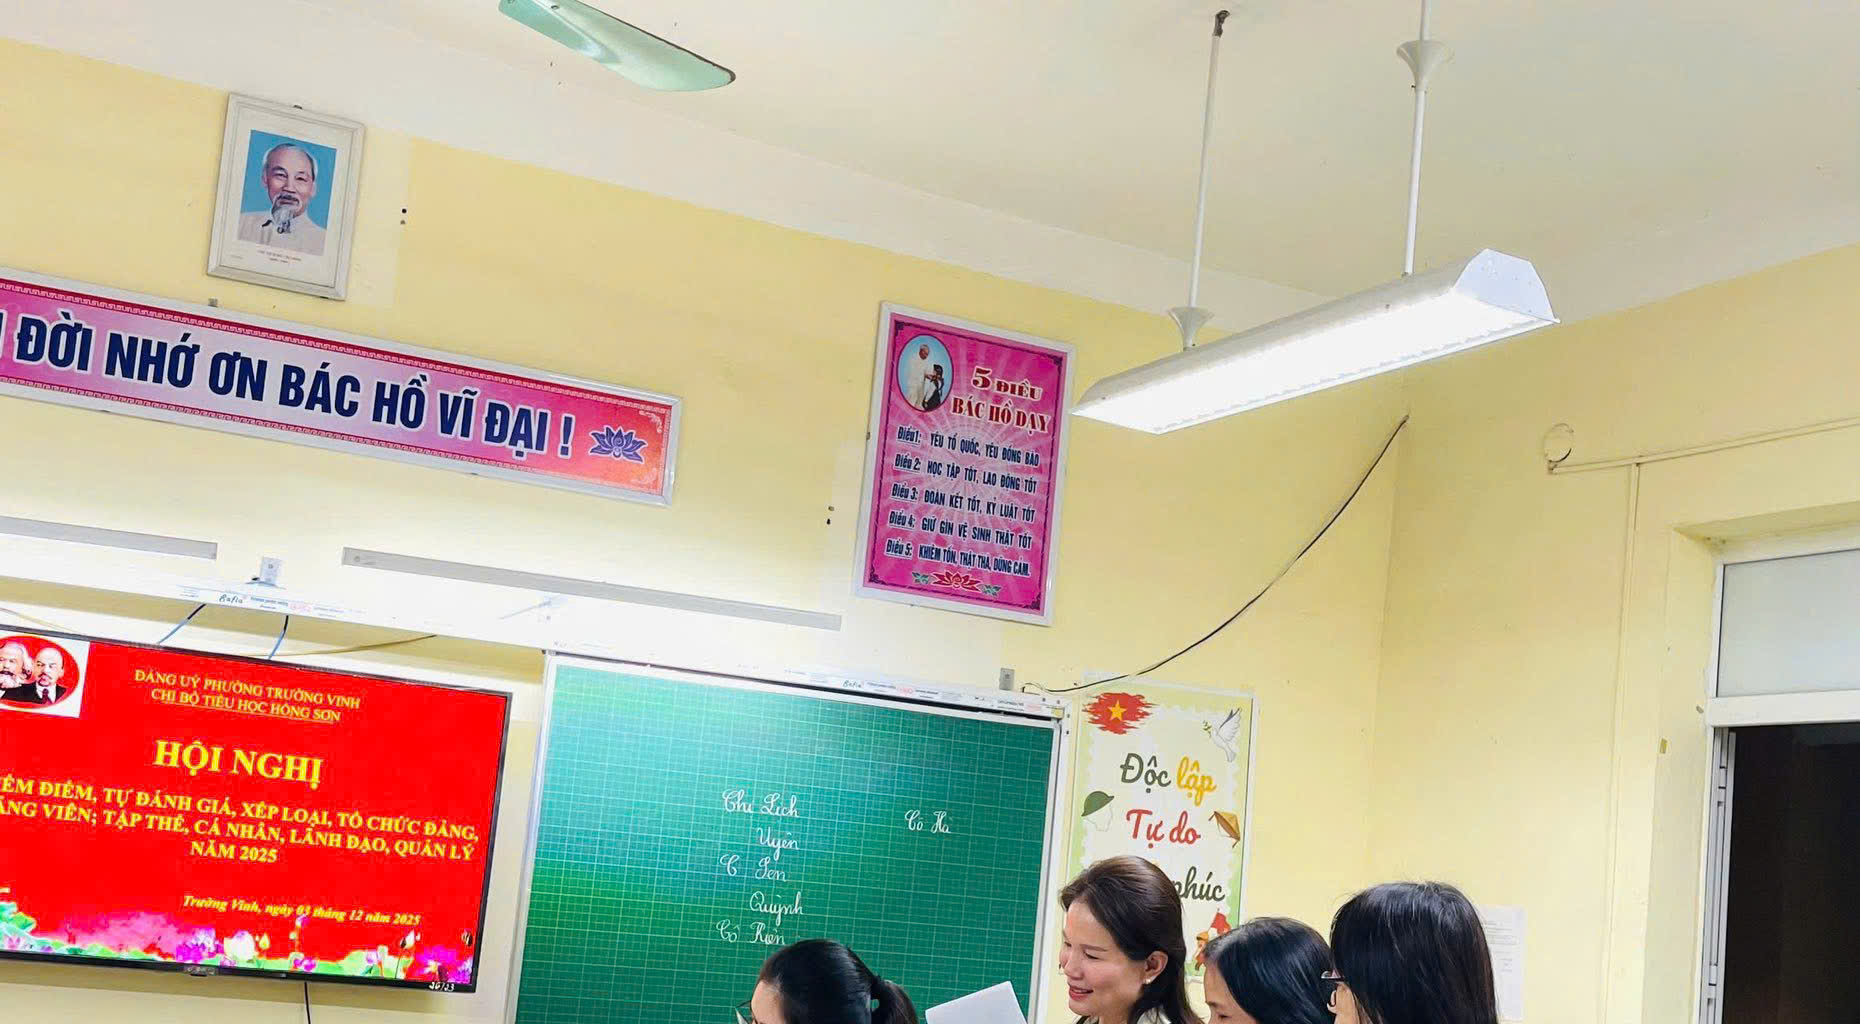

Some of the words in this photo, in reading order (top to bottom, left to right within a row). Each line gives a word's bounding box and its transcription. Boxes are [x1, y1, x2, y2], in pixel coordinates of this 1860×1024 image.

[15, 311, 91, 372] ĐỜI
[104, 331, 200, 389] NHỚ
[209, 350, 269, 401] ƠN
[279, 361, 360, 419] BÁC
[373, 374, 428, 430] HỒ
[440, 389, 477, 438] VĨ
[485, 403, 547, 457] ĐẠI
[972, 367, 991, 389] 5
[996, 379, 1042, 400] ĐIỀU
[952, 396, 985, 419] BÁC
[989, 400, 1012, 425] HỒ
[1016, 411, 1050, 435] DẠY
[927, 460, 942, 478] HỌC
[947, 462, 960, 481] TẬP
[983, 471, 997, 486] LAO
[1000, 473, 1020, 491] ĐỘNG
[1024, 477, 1037, 494] TỐT
[949, 491, 963, 510] KẾT
[986, 497, 997, 516] KỶ
[1000, 504, 1019, 522] LUẬT
[1022, 505, 1035, 523] TỐT
[958, 522, 968, 541] VỆ
[972, 526, 992, 542] SINH
[995, 529, 1014, 549] THẬT
[1019, 532, 1032, 549] TỐT
[960, 550, 976, 569] THẬT
[151, 688, 177, 702] CHI
[179, 690, 200, 706] BỘ
[237, 698, 267, 714] HỌC
[313, 708, 342, 722] SƠN
[204, 677, 264, 697] PHƯỜNG
[266, 685, 323, 704] TRƯỜNG
[327, 693, 361, 709] VINH
[153, 739, 223, 776] HỘI
[231, 747, 324, 791] NGHỊ
[1120, 752, 1172, 794] Độc
[1176, 756, 1217, 807] lập
[0, 774, 35, 795] ỂM
[103, 787, 134, 808] TỰ
[135, 789, 193, 812] ĐÁNH
[196, 797, 238, 819] GIÁ,
[281, 806, 332, 828] LOẠI,
[367, 814, 421, 834] CHỨC
[42, 802, 98, 826] VIÊN;
[103, 809, 143, 831] TẬP
[193, 817, 222, 837] CÁ
[225, 821, 285, 844] NHÂN,
[289, 828, 342, 849] LÃNH
[346, 834, 391, 855] ĐẠO,
[449, 843, 476, 862] LÝ
[756, 826, 800, 861] Uyên
[1126, 808, 1165, 849] Tự
[1169, 811, 1201, 845] do
[189, 839, 235, 860] NĂM
[240, 846, 279, 864] 2025
[184, 895, 228, 912] Trường
[231, 898, 261, 914] Vinh,
[265, 904, 294, 918] ngày
[312, 906, 347, 922] tháng
[349, 909, 364, 921] 12
[365, 912, 391, 923] năm
[393, 913, 422, 926] 2025
